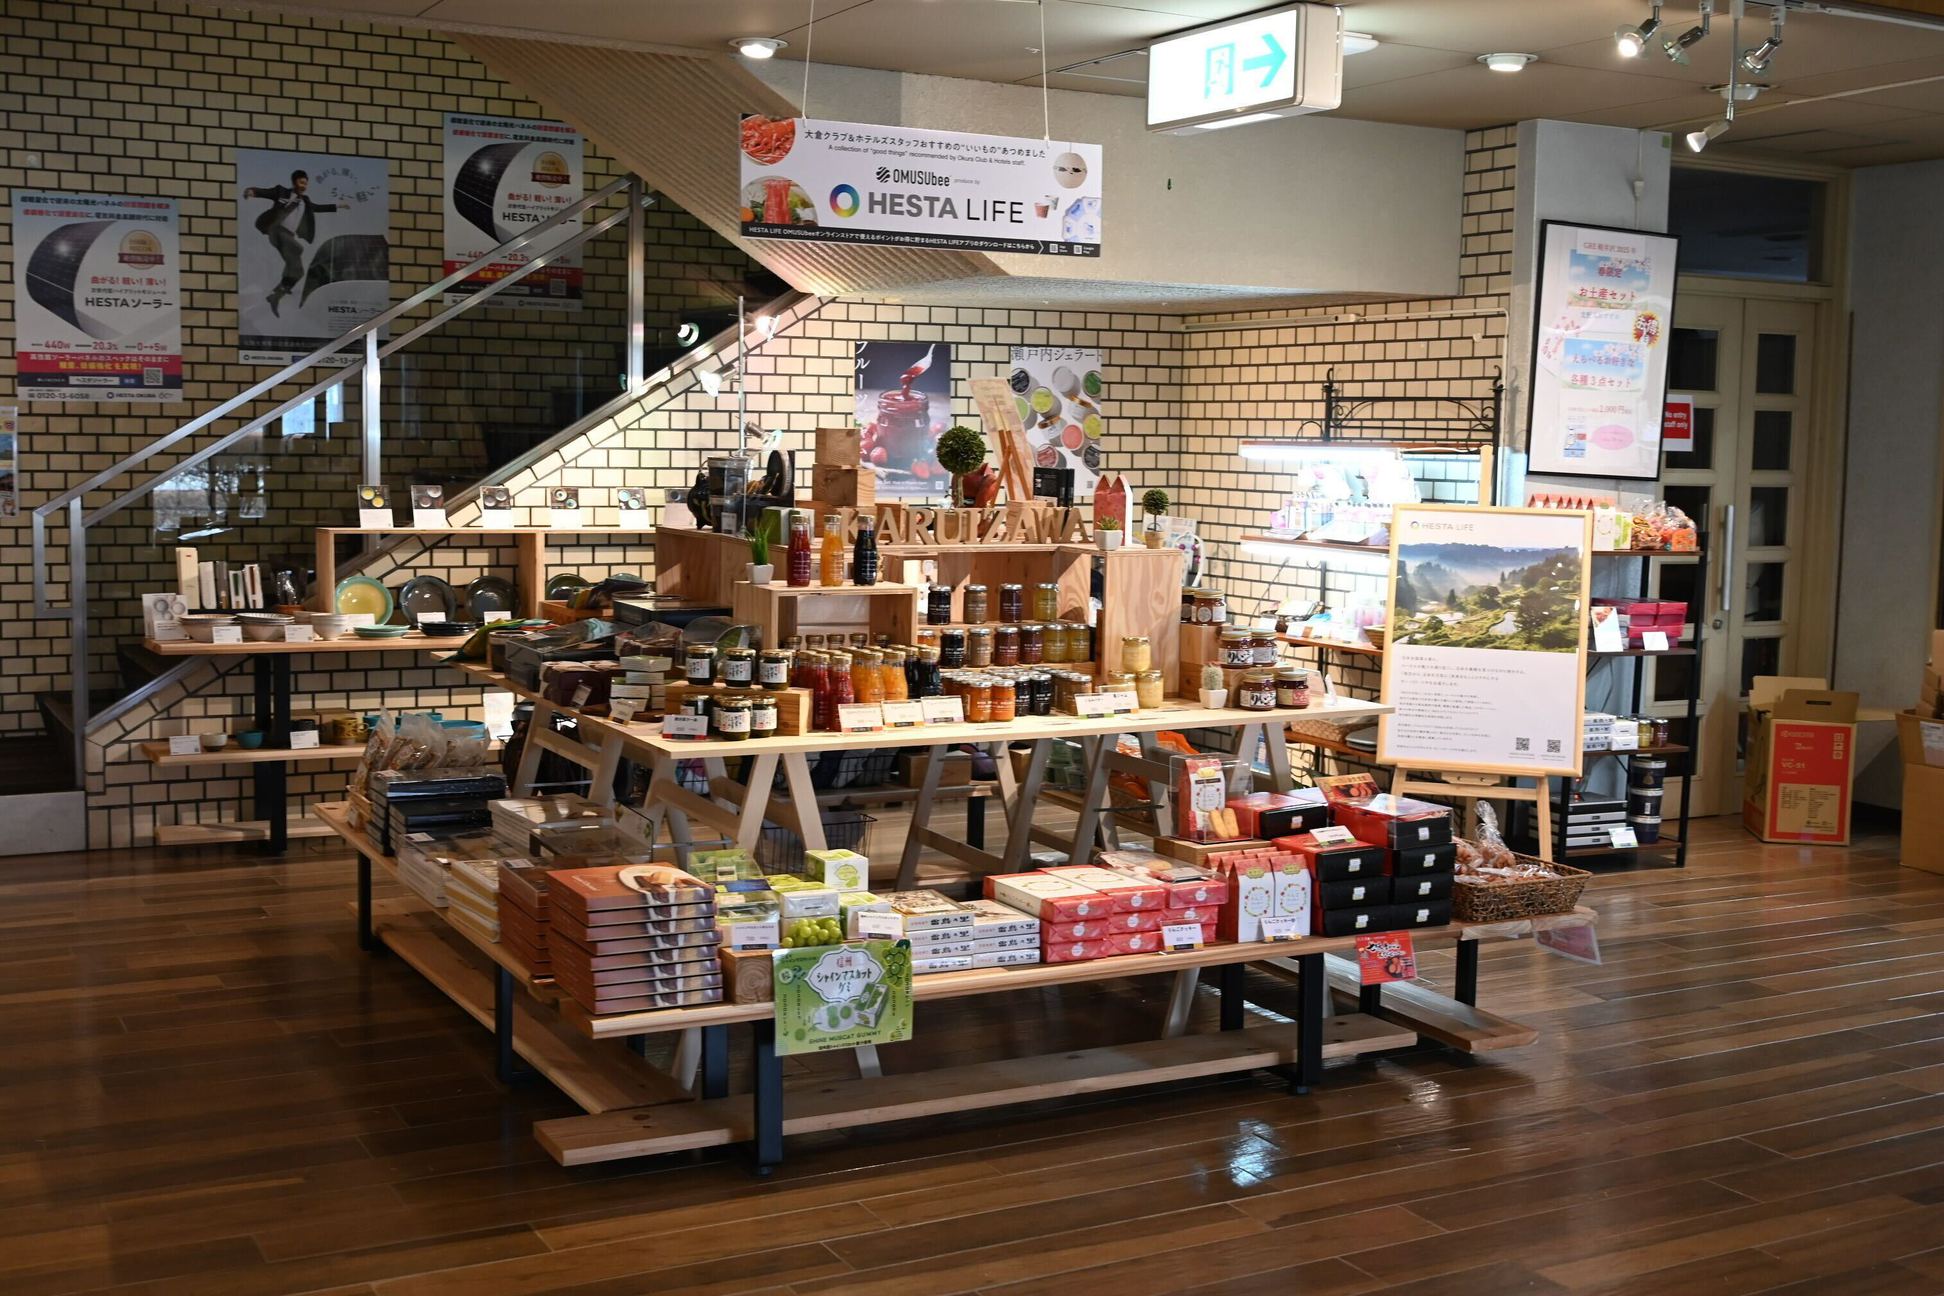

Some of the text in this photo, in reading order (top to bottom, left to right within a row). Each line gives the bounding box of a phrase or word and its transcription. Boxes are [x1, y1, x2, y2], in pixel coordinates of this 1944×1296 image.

[909, 152, 948, 160] recommended
[893, 168, 950, 187] OMUSUbee
[868, 192, 1024, 224] HESTA LIFE
[1673, 412, 1687, 420] entry
[836, 506, 1094, 545] KARUIZAWA
[1422, 522, 1474, 532] HESTA LIFE
[817, 968, 872, 983] シャインマスカット
